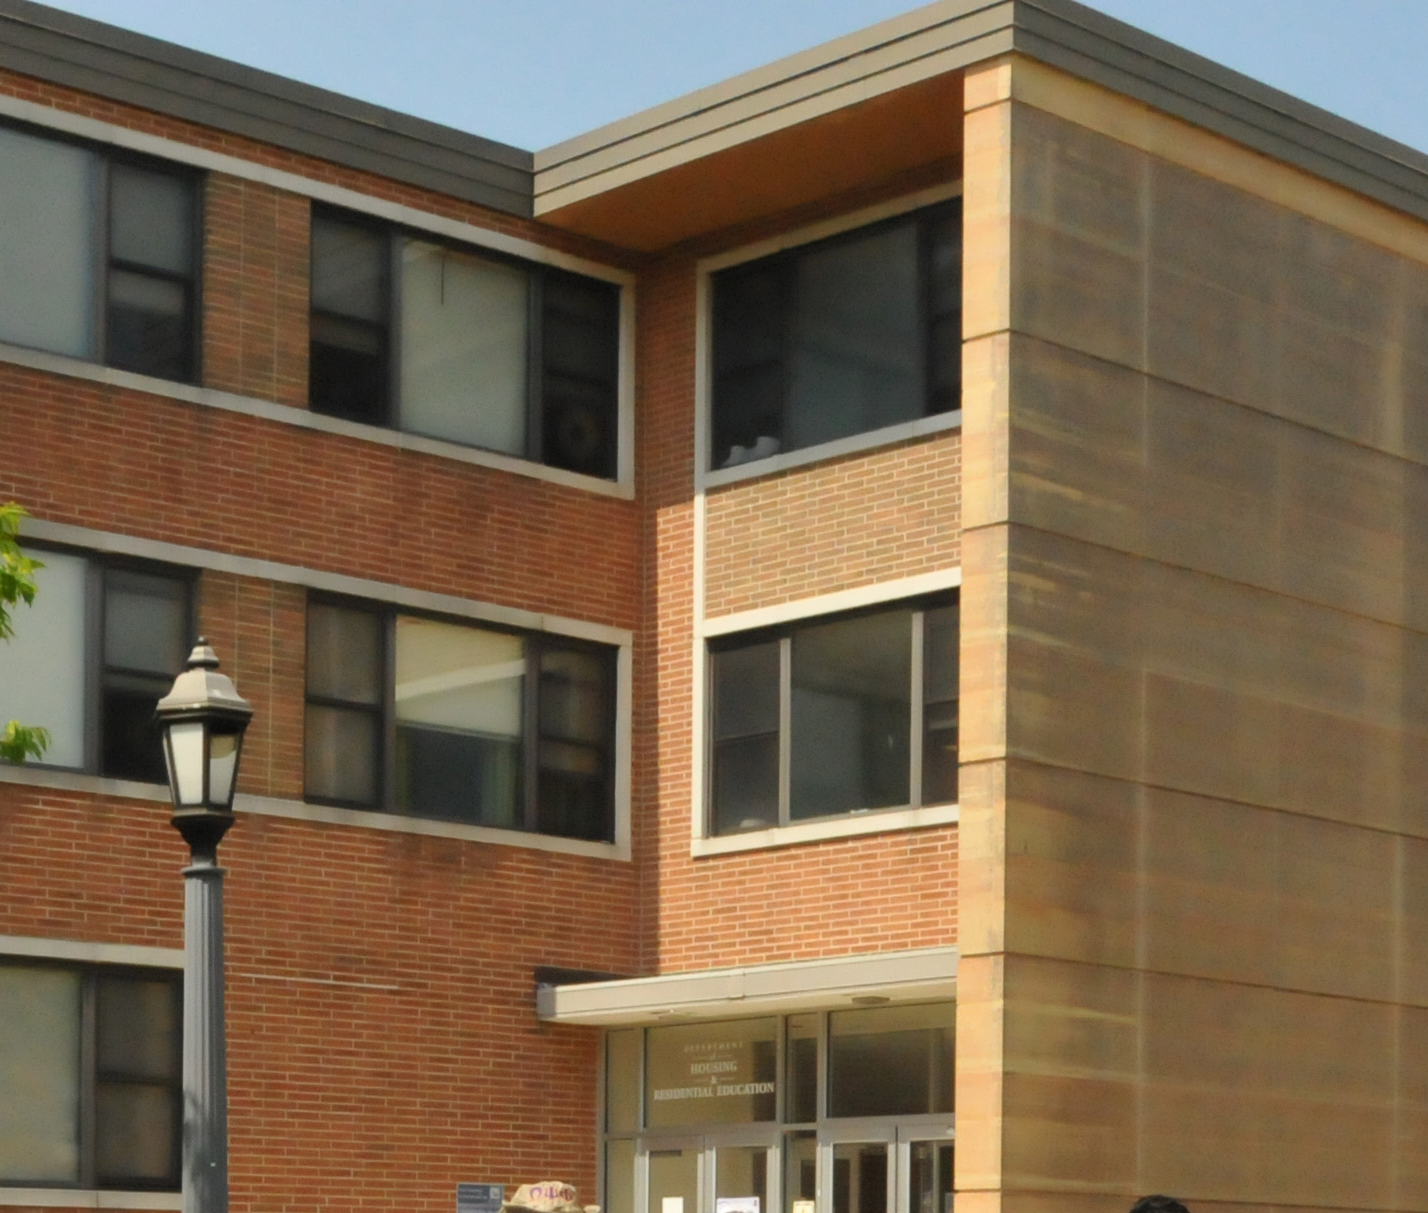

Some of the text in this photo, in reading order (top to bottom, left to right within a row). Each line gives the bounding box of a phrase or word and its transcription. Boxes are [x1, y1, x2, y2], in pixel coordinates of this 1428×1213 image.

[691, 1061, 737, 1074] HOUSING
[711, 1075, 718, 1085] &
[654, 1082, 775, 1100] RESIDENTIAL EDUCATION
